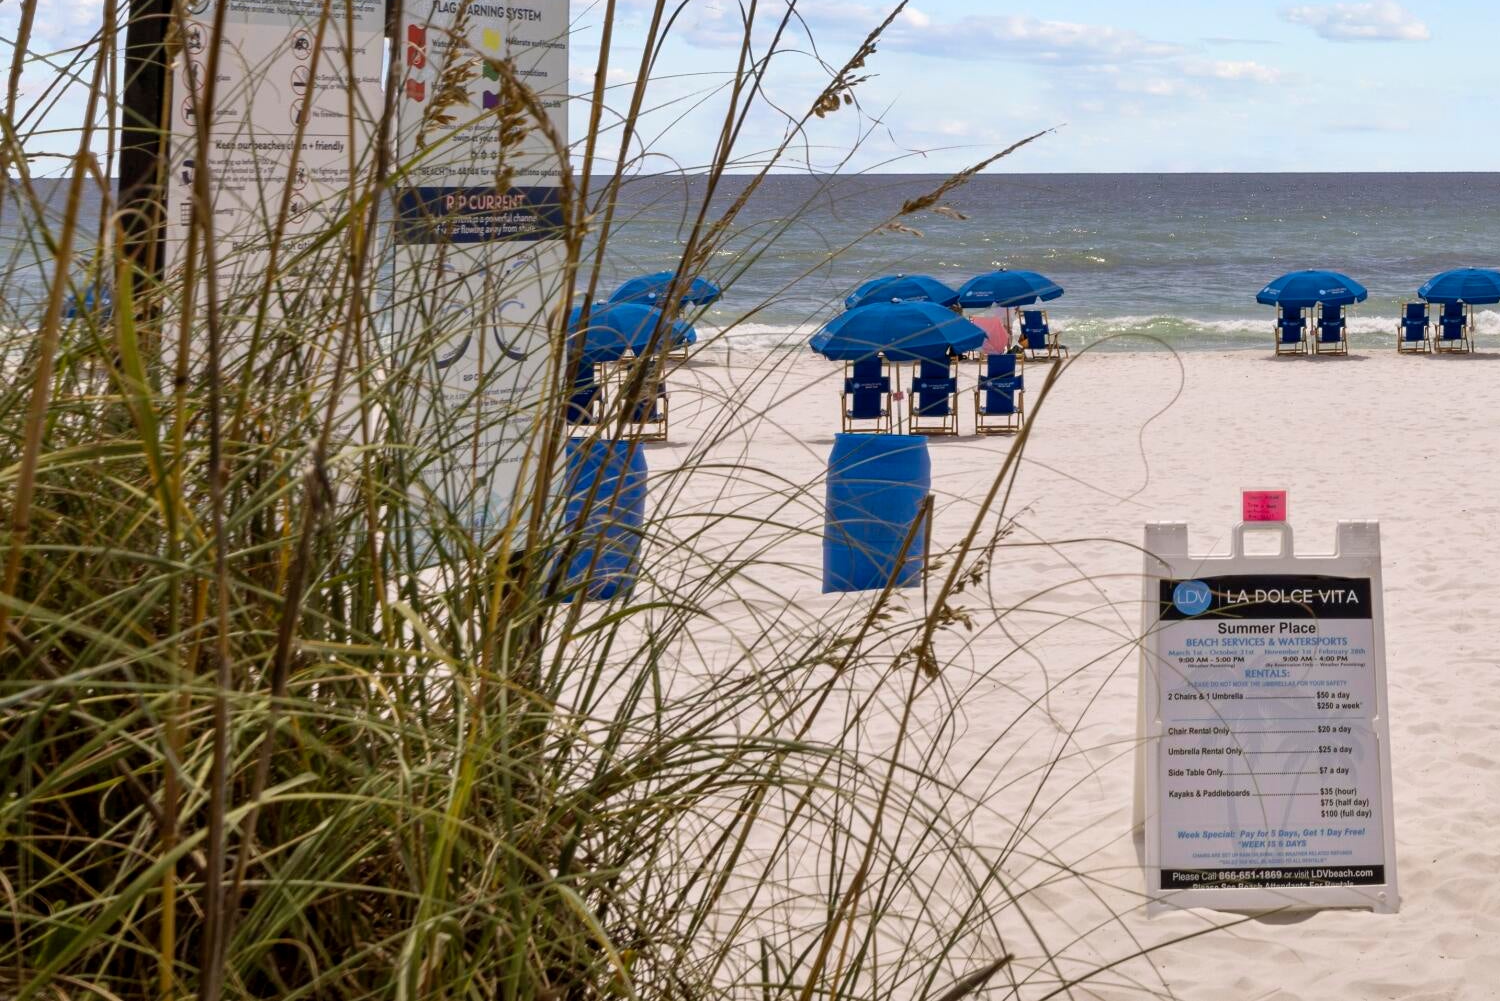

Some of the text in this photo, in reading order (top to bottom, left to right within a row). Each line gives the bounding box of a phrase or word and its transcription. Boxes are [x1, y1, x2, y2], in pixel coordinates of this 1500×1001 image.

[458, 3, 505, 18] ARNING
[505, 6, 542, 22] SYSTEM
[315, 140, 345, 153] friendly
[446, 194, 526, 211] RP CURRENT
[1177, 588, 1208, 605] LDV
[1226, 588, 1360, 605] LA DOLCE VITA
[1217, 621, 1317, 635] Summer Place
[1185, 636, 1348, 647] BEACH SERVICES & WATERSPORTS
[1318, 648, 1349, 656] February
[1244, 668, 1291, 678] RENTALS:
[1316, 691, 1329, 699] $50
[1338, 691, 1350, 700] day
[1317, 702, 1334, 710] $250
[1168, 727, 1188, 735] Chair
[1189, 727, 1212, 735] Rental
[1213, 727, 1230, 737] Only
[1317, 725, 1331, 733] $20
[1338, 725, 1352, 734] day
[1168, 747, 1200, 756] Umbrella
[1201, 747, 1225, 755] Rental
[1226, 747, 1243, 757] Only
[1318, 745, 1332, 754] $25
[1339, 745, 1353, 755] day
[1168, 769, 1184, 777] Side
[1186, 769, 1205, 777] Table
[1206, 769, 1223, 778] Only
[1319, 766, 1328, 775] $7
[1335, 766, 1349, 776] day
[1168, 790, 1195, 798] Kayaks
[1203, 789, 1250, 798] Paddleboards
[1320, 787, 1333, 796] $35
[1335, 787, 1358, 796] (hour)
[1320, 798, 1370, 808] $75 (half day)
[1321, 809, 1373, 819] $100 (full day)
[1177, 831, 1201, 839] Week
[1201, 830, 1236, 840] Special:
[1239, 830, 1256, 839] Pay
[1257, 830, 1269, 838] for
[1271, 829, 1276, 837] 5
[1278, 829, 1300, 839] Days,
[1303, 828, 1318, 837] Get
[1327, 828, 1342, 838] Day
[1344, 827, 1366, 836] Free!
[1285, 839, 1307, 847] DAYS
[1172, 872, 1199, 881] Please
[1201, 871, 1217, 880] Call
[1218, 870, 1282, 880] 866-651-1869
[1293, 870, 1310, 879] visit
[1311, 868, 1373, 878] LDVbeach.com
